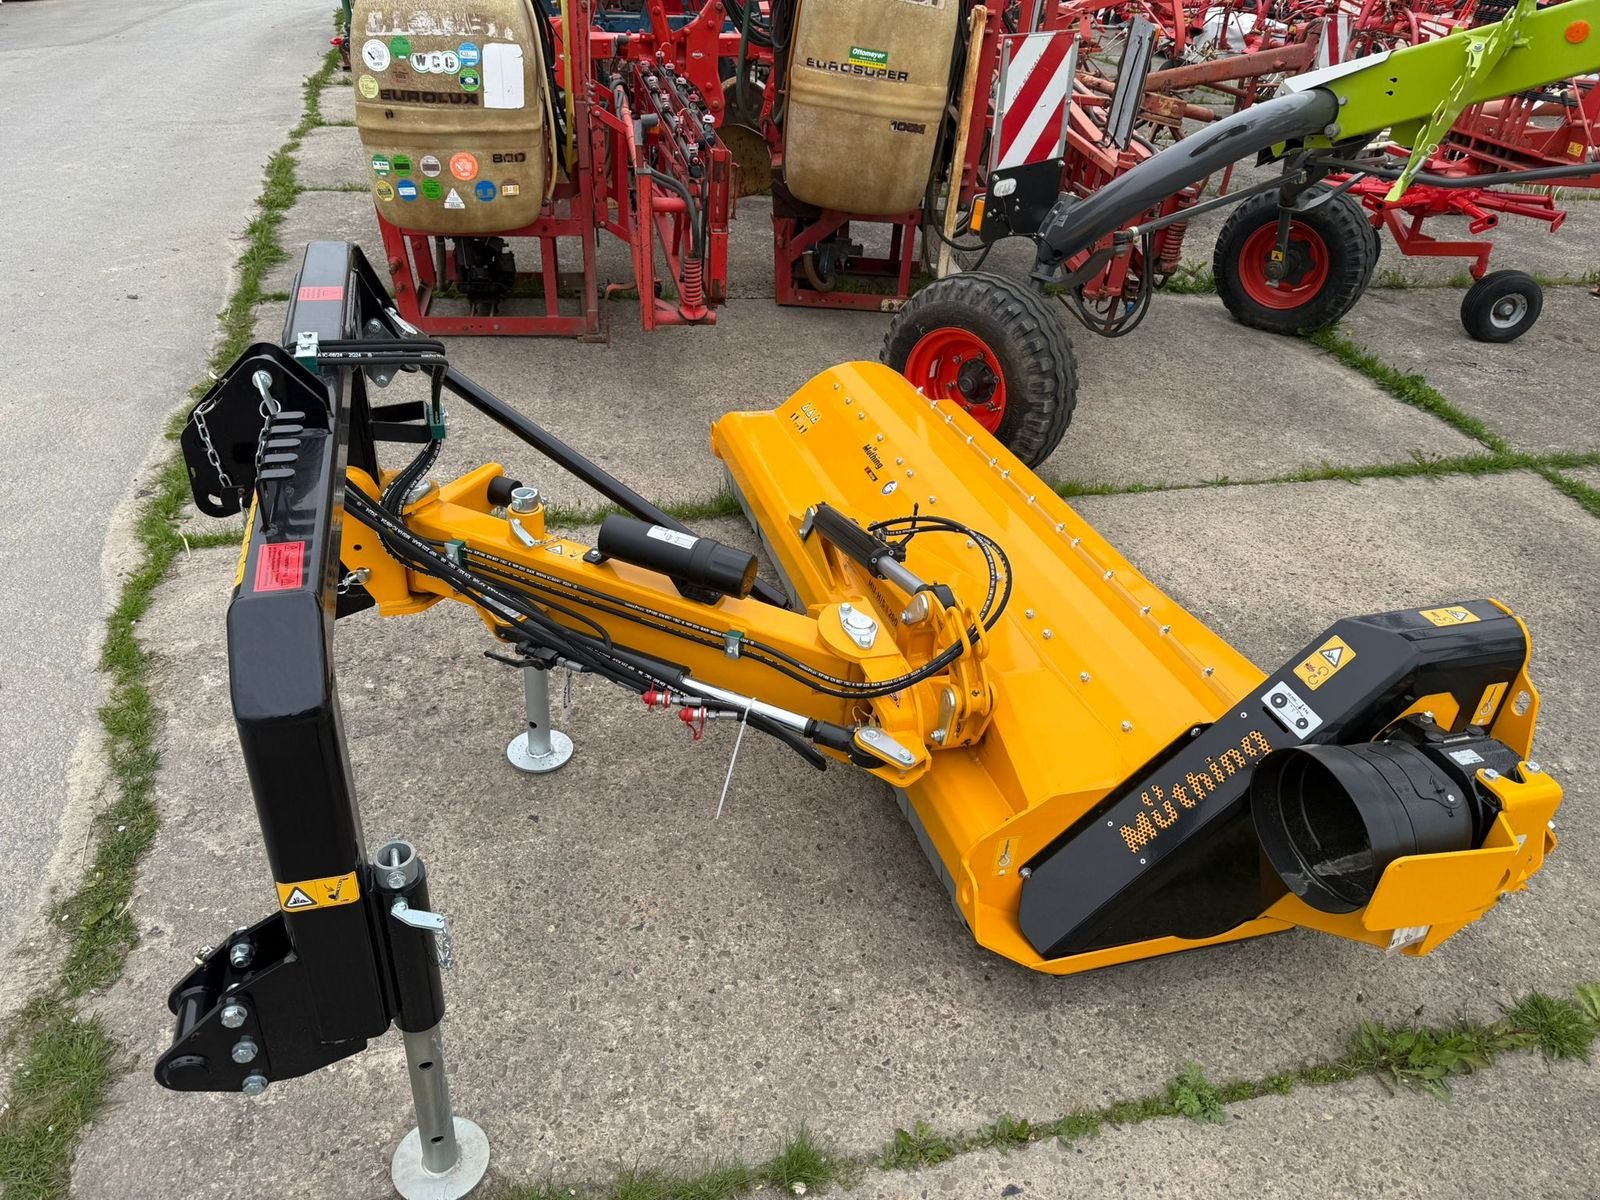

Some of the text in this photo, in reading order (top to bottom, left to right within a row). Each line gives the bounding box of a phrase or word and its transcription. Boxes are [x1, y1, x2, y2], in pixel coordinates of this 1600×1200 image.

[852, 47, 886, 59] Ottomeyer
[806, 57, 909, 81] EUROSUPER
[380, 89, 478, 106] EUROLUX
[492, 152, 526, 163] 800
